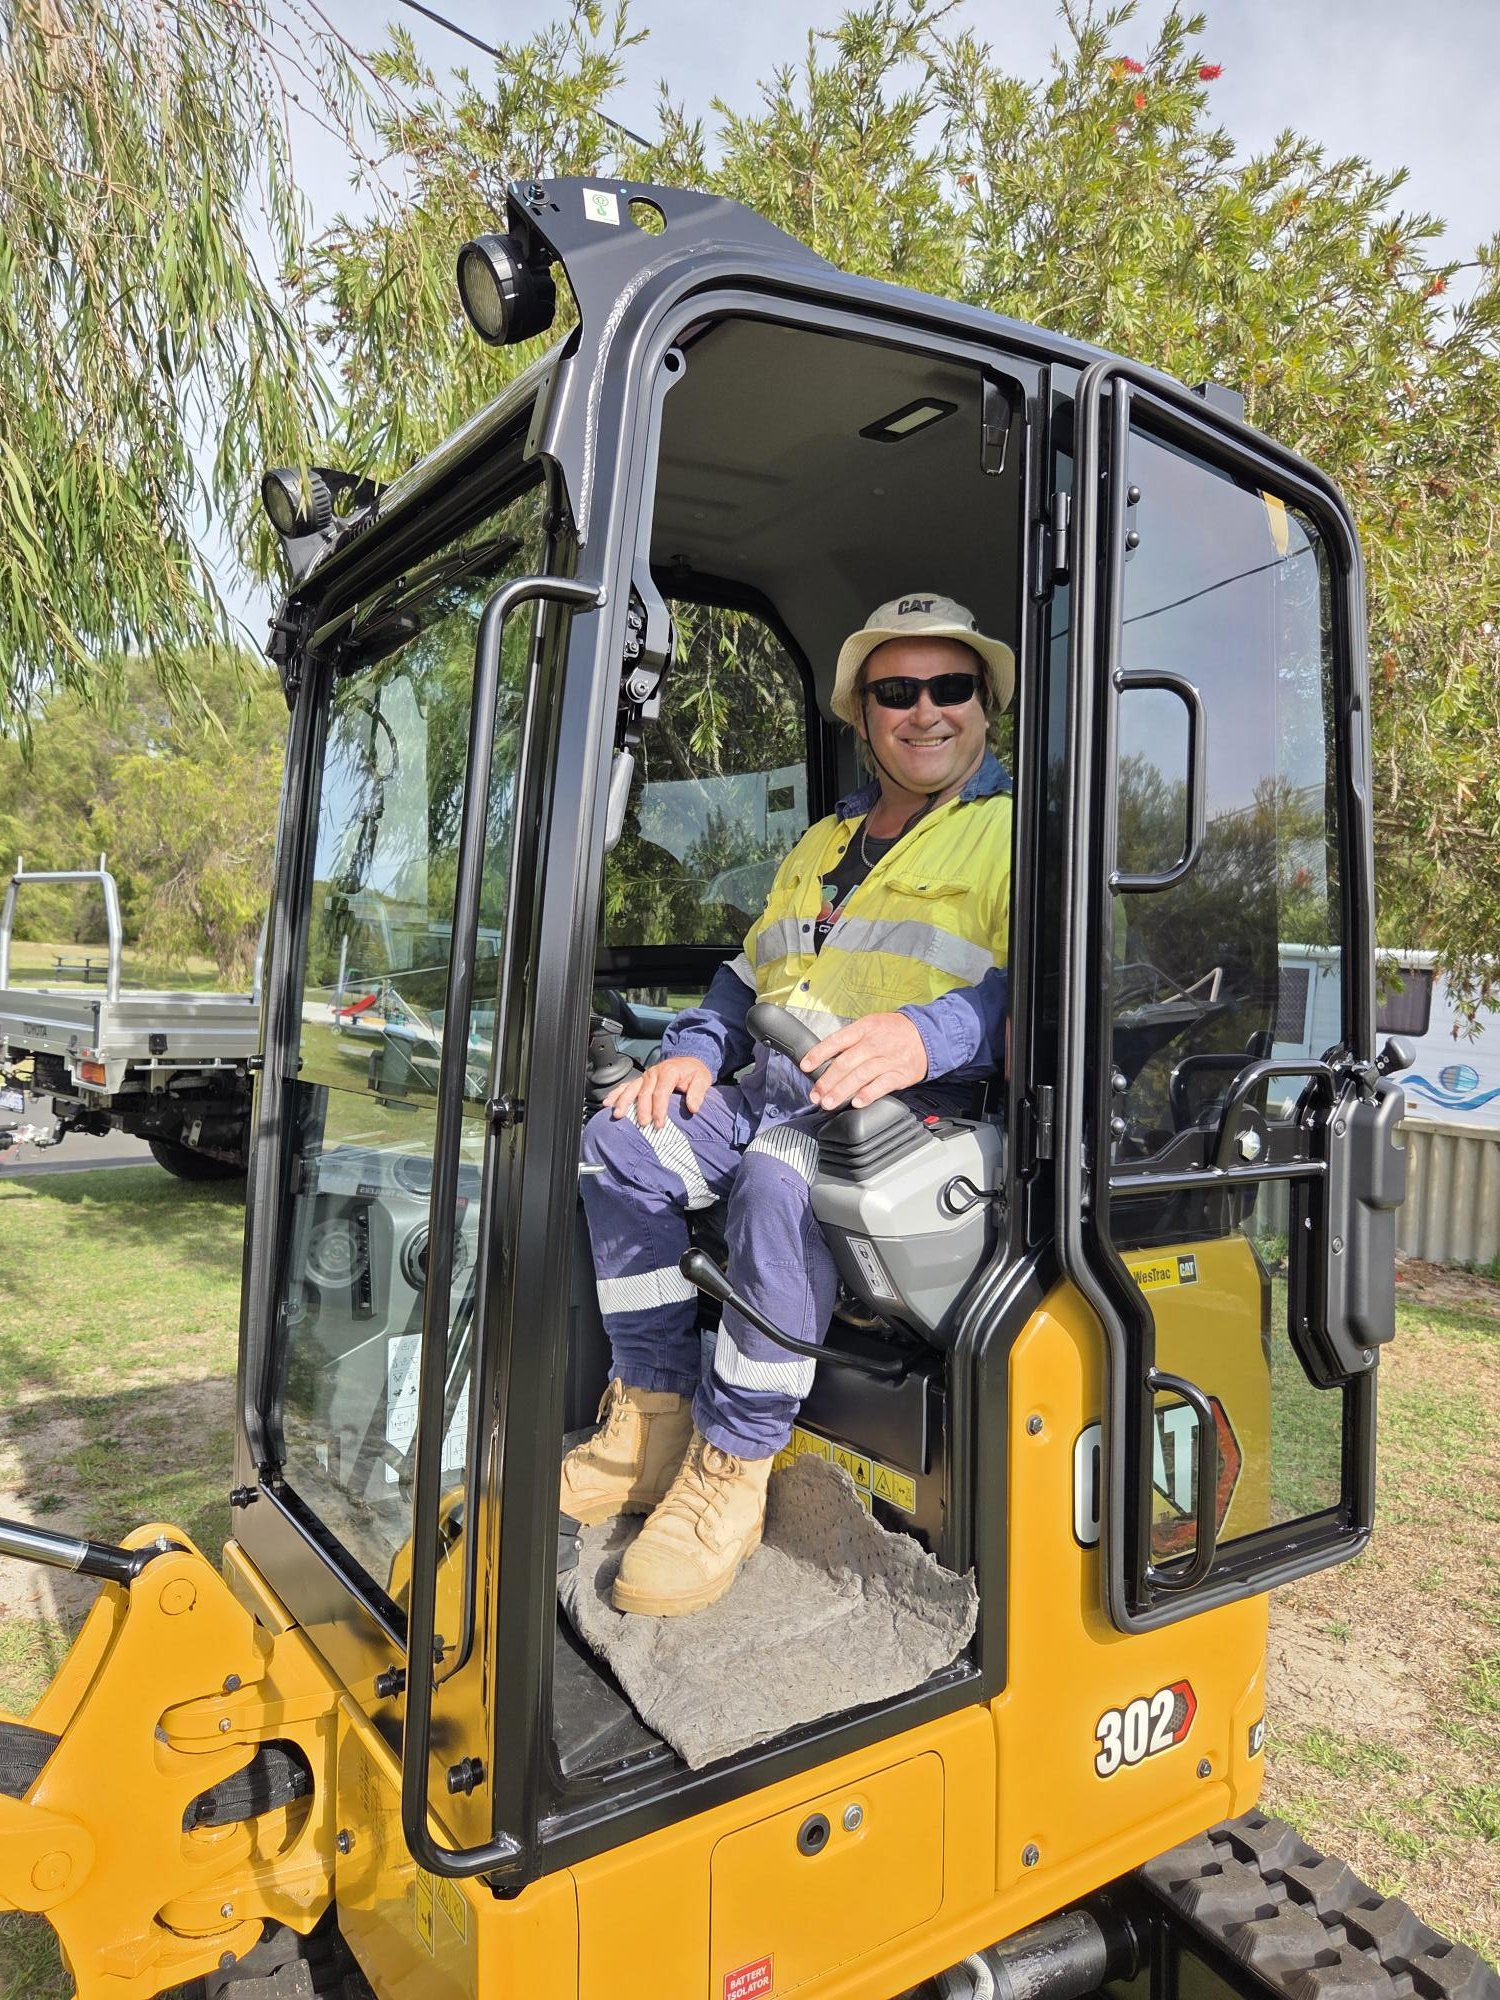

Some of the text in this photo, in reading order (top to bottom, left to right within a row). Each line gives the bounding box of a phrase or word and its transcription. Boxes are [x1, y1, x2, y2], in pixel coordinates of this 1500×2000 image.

[897, 599, 935, 616] CAT
[1132, 1261, 1194, 1284] WesTrac CAT
[1096, 1688, 1175, 1775] 302
[726, 1976, 769, 2000] ISOLATOR
[730, 1964, 768, 1990] BATTERY
